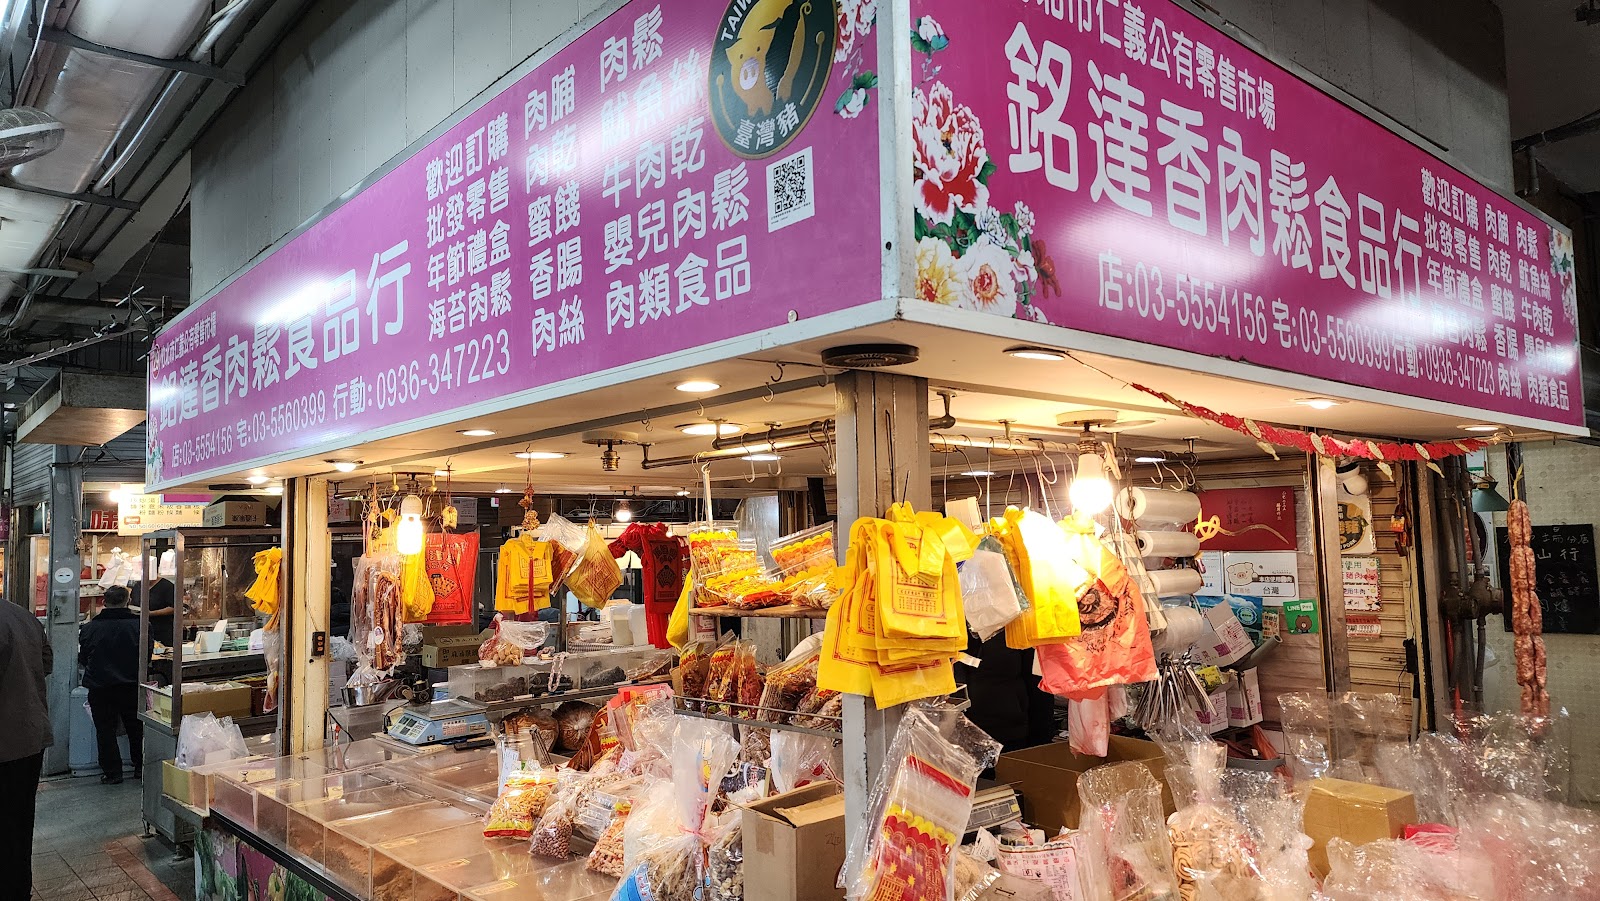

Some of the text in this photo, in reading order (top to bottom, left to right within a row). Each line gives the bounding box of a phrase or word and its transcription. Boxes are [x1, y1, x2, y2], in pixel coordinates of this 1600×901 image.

[600, 3, 665, 93] 肉鬆
[1021, 0, 1277, 131] 市仁義公有零售市場
[524, 65, 576, 140] 肉脯
[734, 102, 799, 150] 臺灣豬
[425, 112, 509, 202] 歡迎訂購
[526, 124, 578, 194] 肉乾
[602, 116, 705, 208] 牛肉乾
[1004, 21, 1424, 308] 銘達香肉鬆食品行
[426, 166, 510, 249] 批發零售
[528, 180, 581, 247] 蜜餞
[604, 161, 750, 274] 嬰兒肉鬆
[1421, 167, 1479, 231] 歡迎訂購
[1485, 203, 1510, 246] 肉脯
[427, 219, 511, 293] 年節禮盒
[529, 237, 583, 301] 香腸
[1424, 211, 1481, 272] 批發零售
[1487, 243, 1512, 284] 肉乾
[1516, 221, 1539, 261] 肉鬆
[428, 270, 512, 342] 海苔肉鬆
[605, 234, 752, 335] 肉類食品
[1098, 248, 1268, 345] 店:03-5554156
[1272, 297, 1391, 371] 宅:03-5560399
[1426, 255, 1485, 312] 年節禮盒
[1490, 283, 1516, 323] 蜜餞
[1518, 259, 1552, 302] 魷魚絲
[531, 295, 585, 357] 肉絲
[1494, 323, 1519, 361] 香腸
[1521, 296, 1554, 337] 牛肉乾
[1497, 362, 1522, 400] 肉絲
[1524, 333, 1567, 375] 嬰兒肉
[171, 329, 511, 469] 店:03-5554156 宅:03-5560399 行動:0936-347223
[1528, 372, 1570, 411] 肉類食品
[1263, 586, 1280, 595] 台灣
